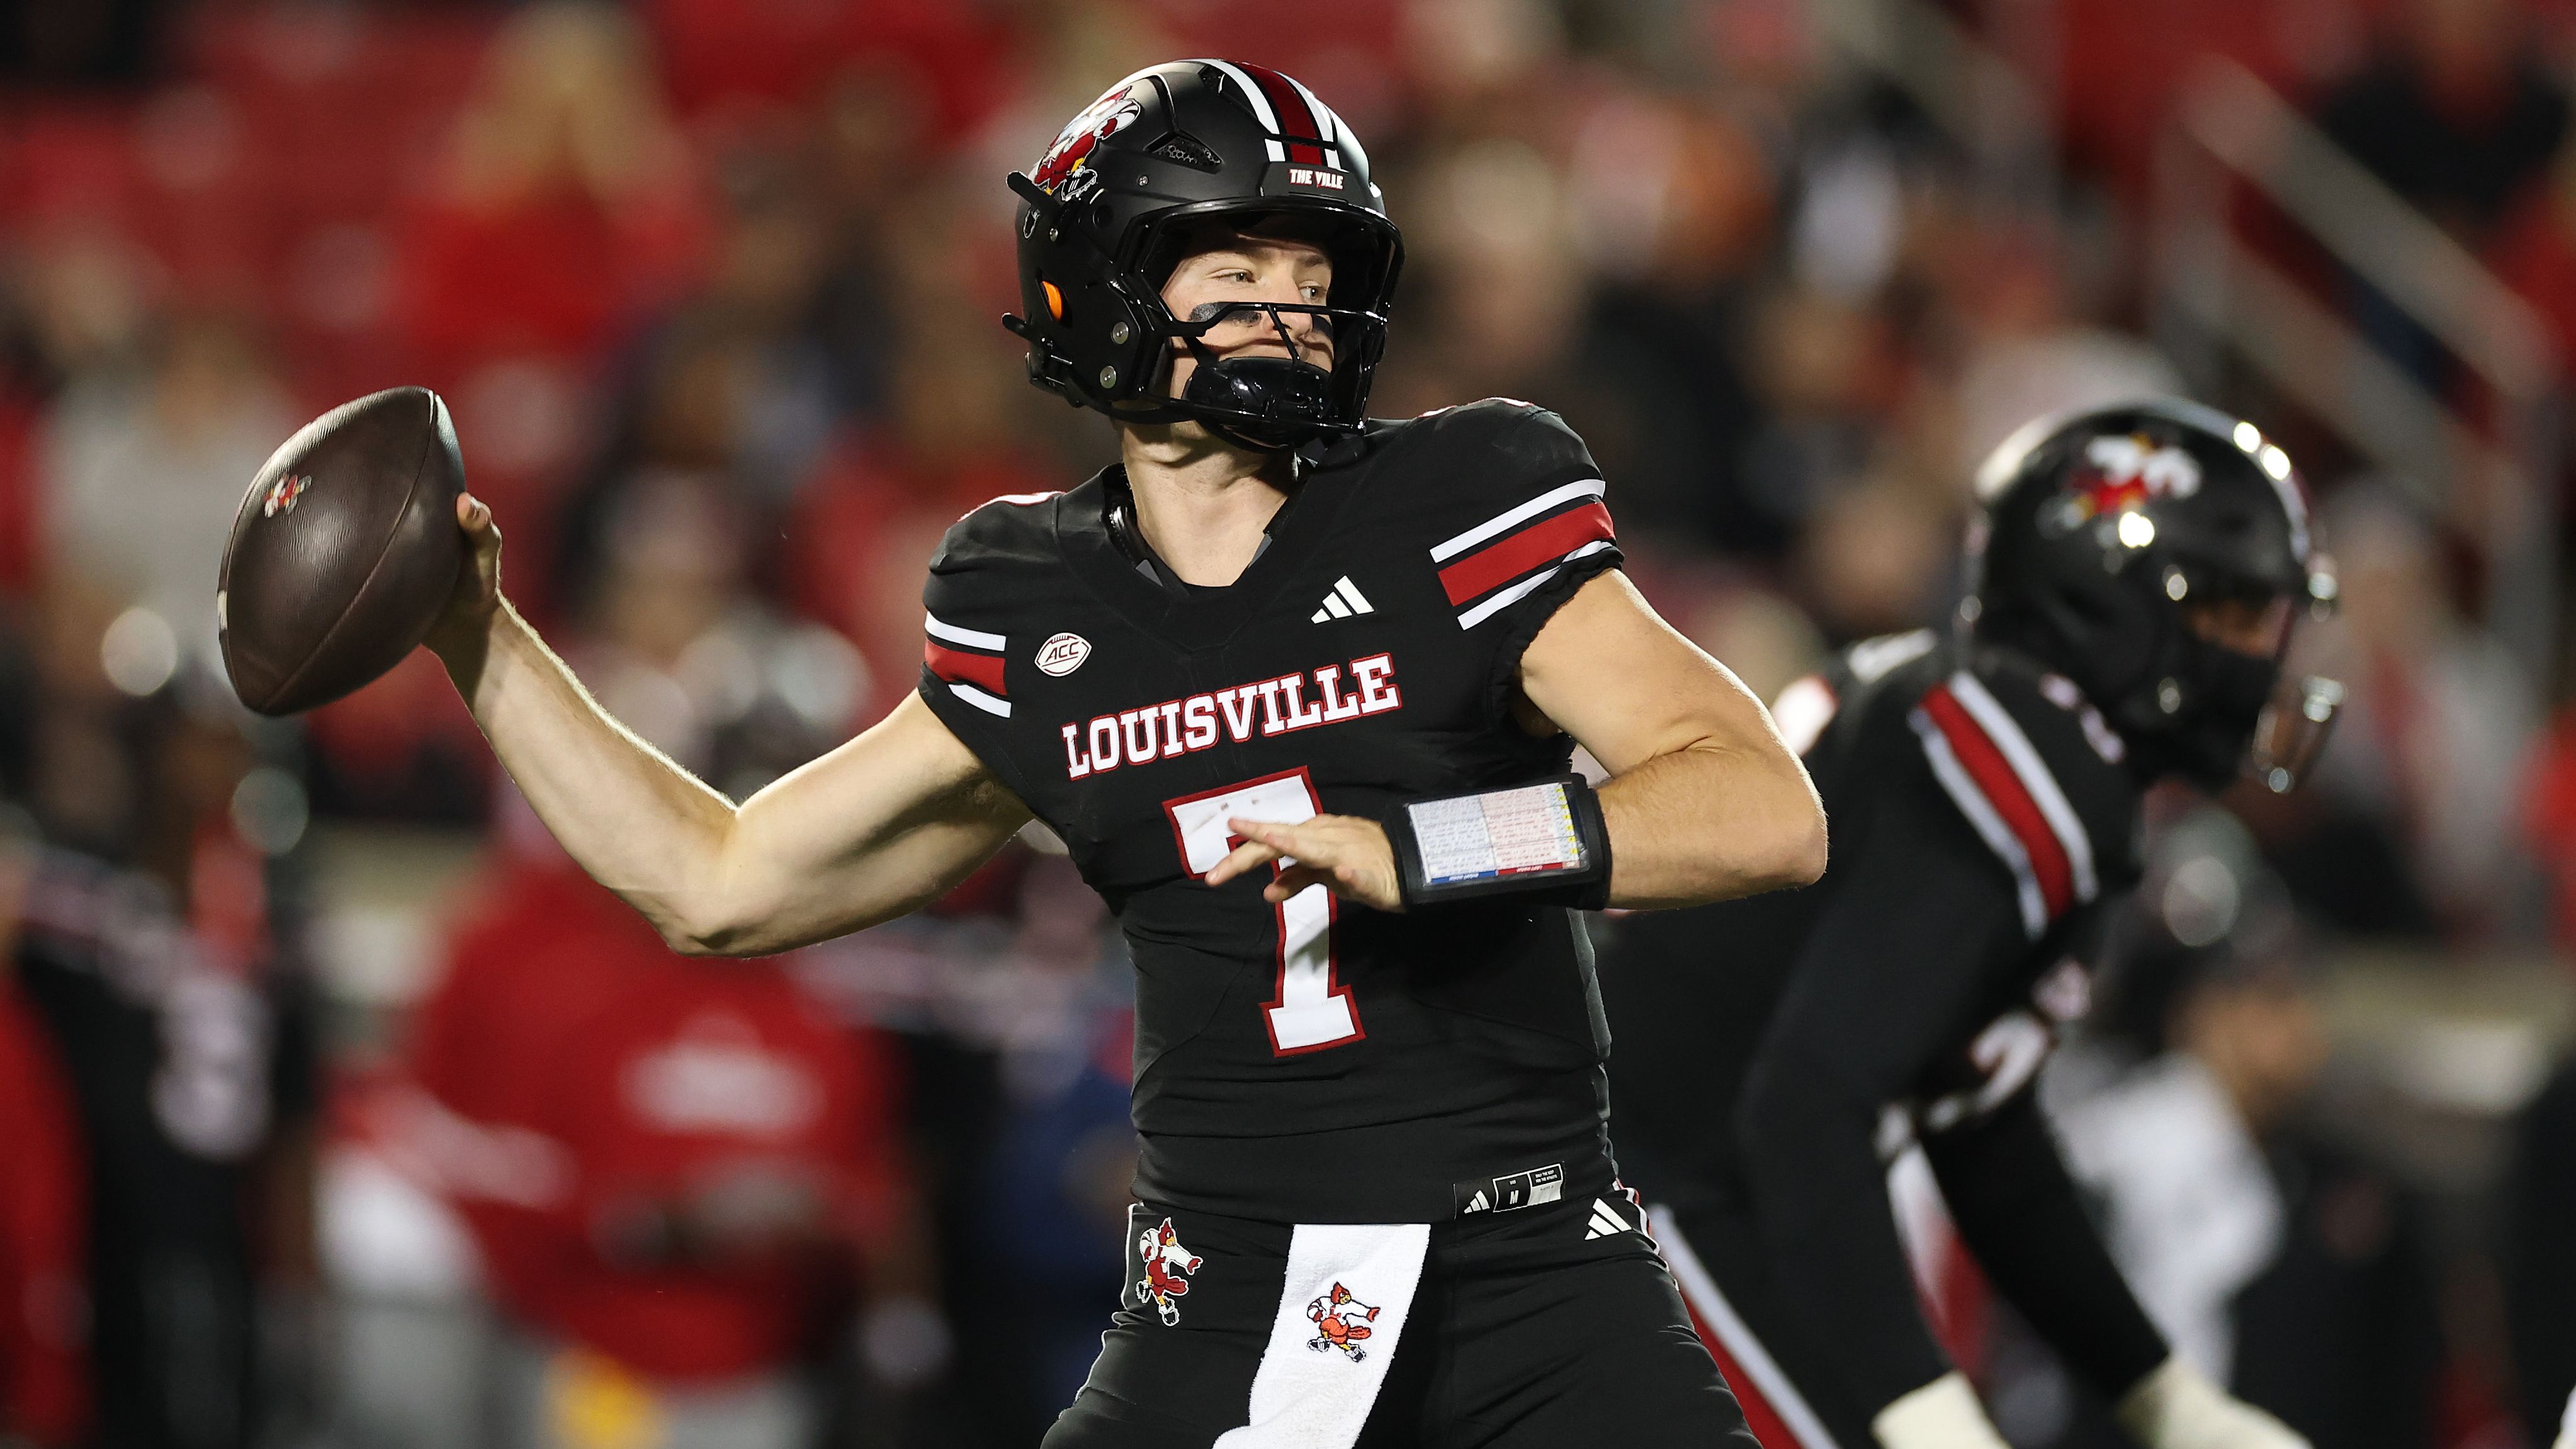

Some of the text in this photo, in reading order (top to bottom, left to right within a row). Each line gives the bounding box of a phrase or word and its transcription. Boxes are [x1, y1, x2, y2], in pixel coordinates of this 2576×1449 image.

[1289, 168, 1344, 191] THE VILLE
[1045, 641, 1080, 663] ACC
[1061, 652, 1403, 781] LOUISVILLE
[1161, 764, 1367, 1058] 7
[1509, 1190, 1519, 1205] M
